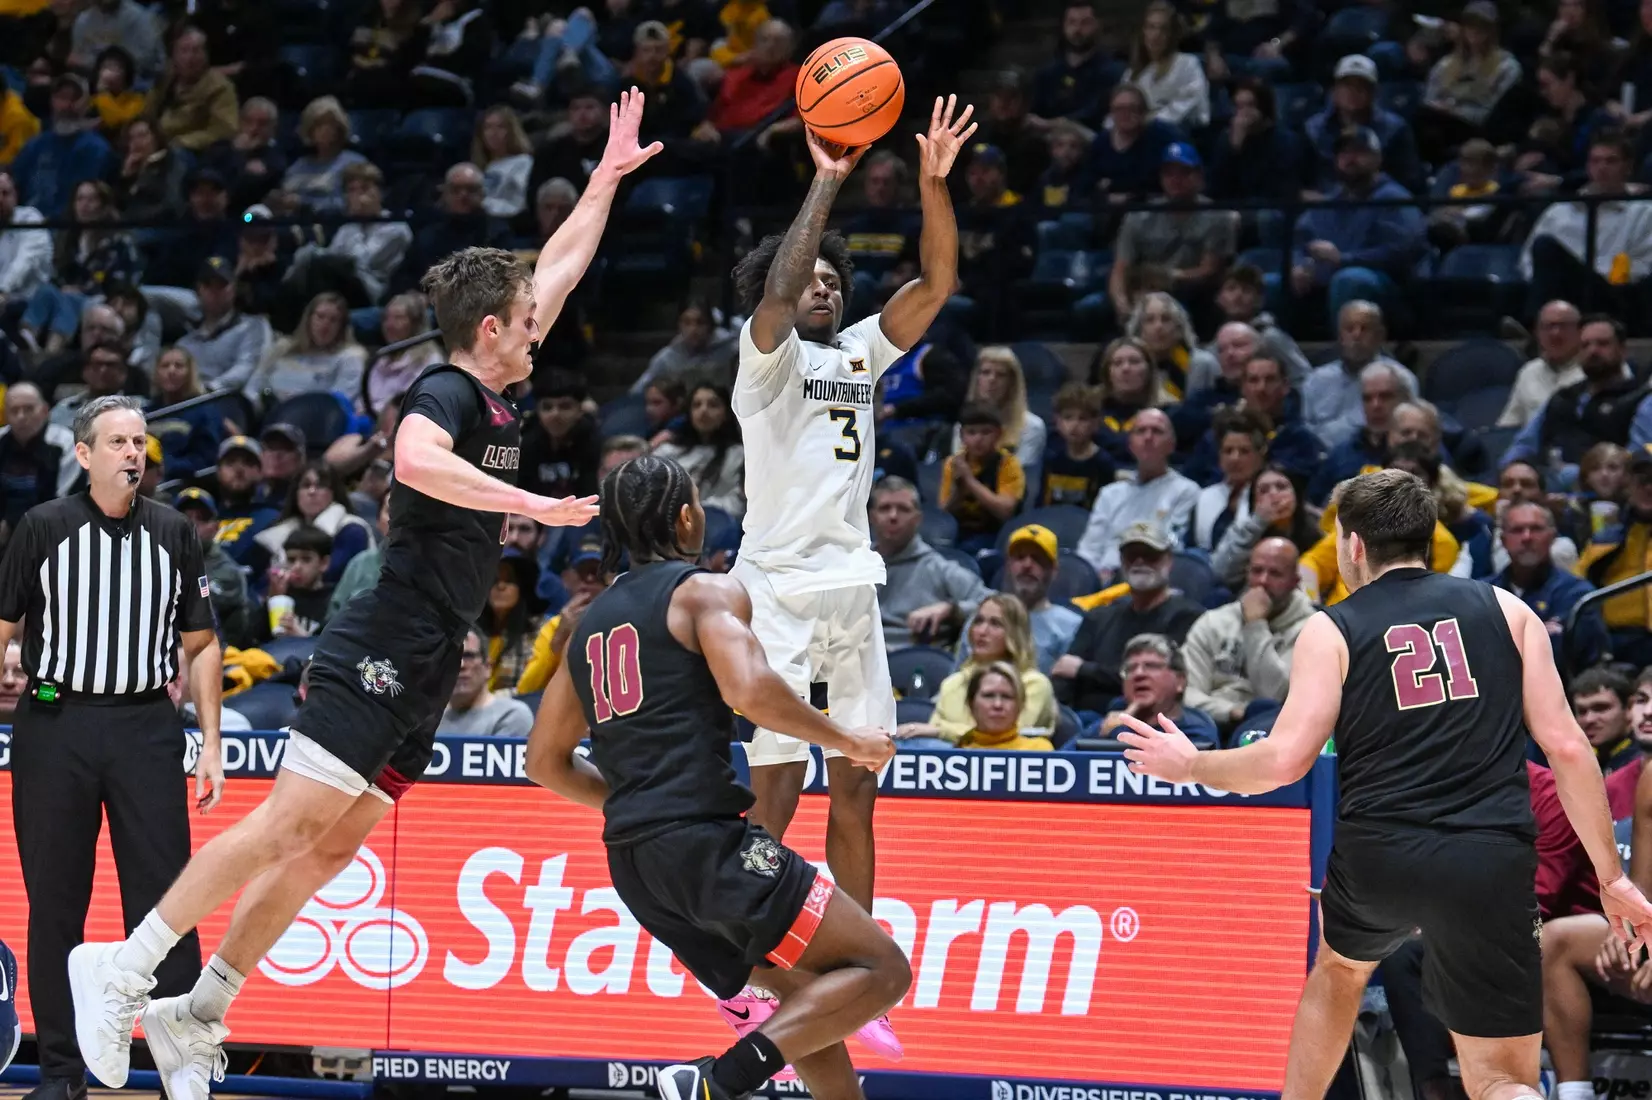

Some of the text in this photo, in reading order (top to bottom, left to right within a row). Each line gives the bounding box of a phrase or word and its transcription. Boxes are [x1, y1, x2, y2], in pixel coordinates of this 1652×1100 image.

[803, 378, 872, 405] MOUNTAINEERS
[828, 407, 861, 462] 3
[585, 622, 643, 724] 10
[1383, 617, 1479, 711] 21
[443, 846, 718, 999] Sta
[424, 1058, 511, 1081] ENERGY
